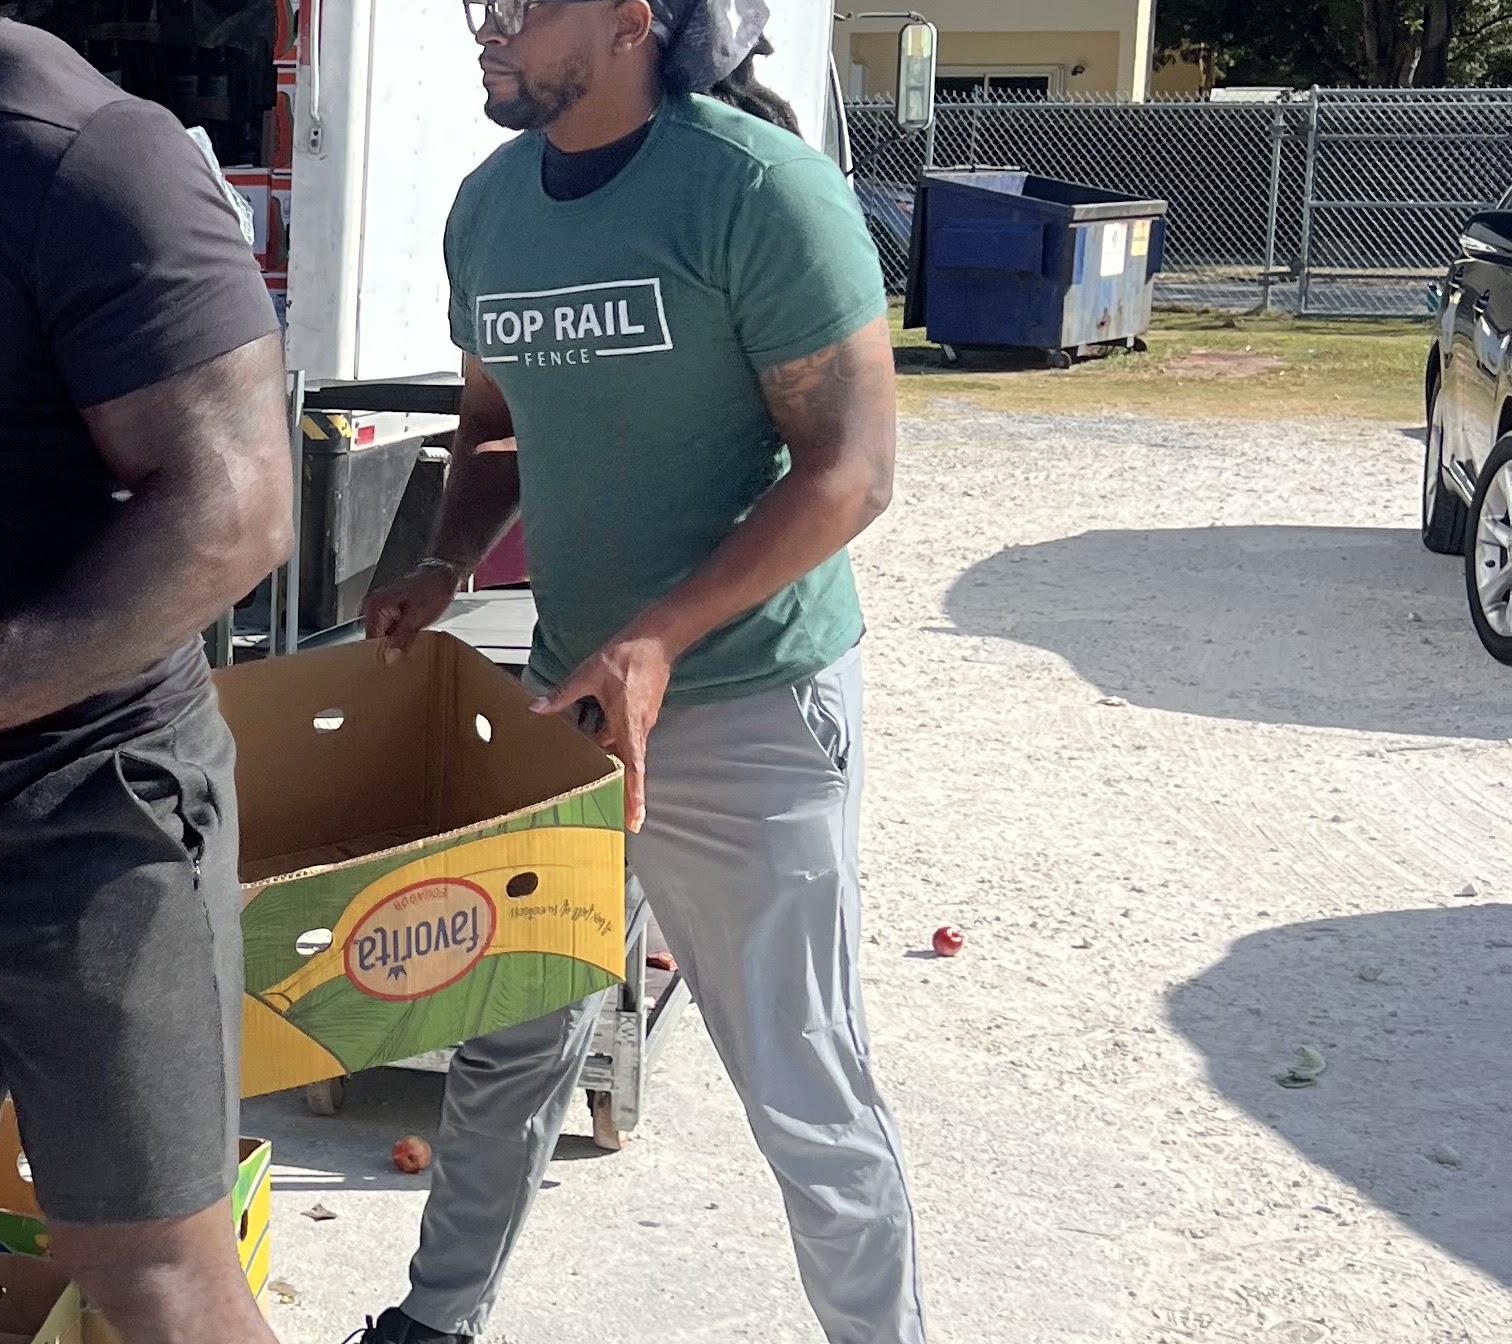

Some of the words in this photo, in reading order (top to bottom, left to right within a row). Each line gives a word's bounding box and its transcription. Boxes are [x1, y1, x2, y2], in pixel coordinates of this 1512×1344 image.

[482, 309, 545, 346] TOP
[553, 299, 646, 342] RAIL
[523, 348, 591, 367] FENCE
[356, 905, 479, 973] favorita
